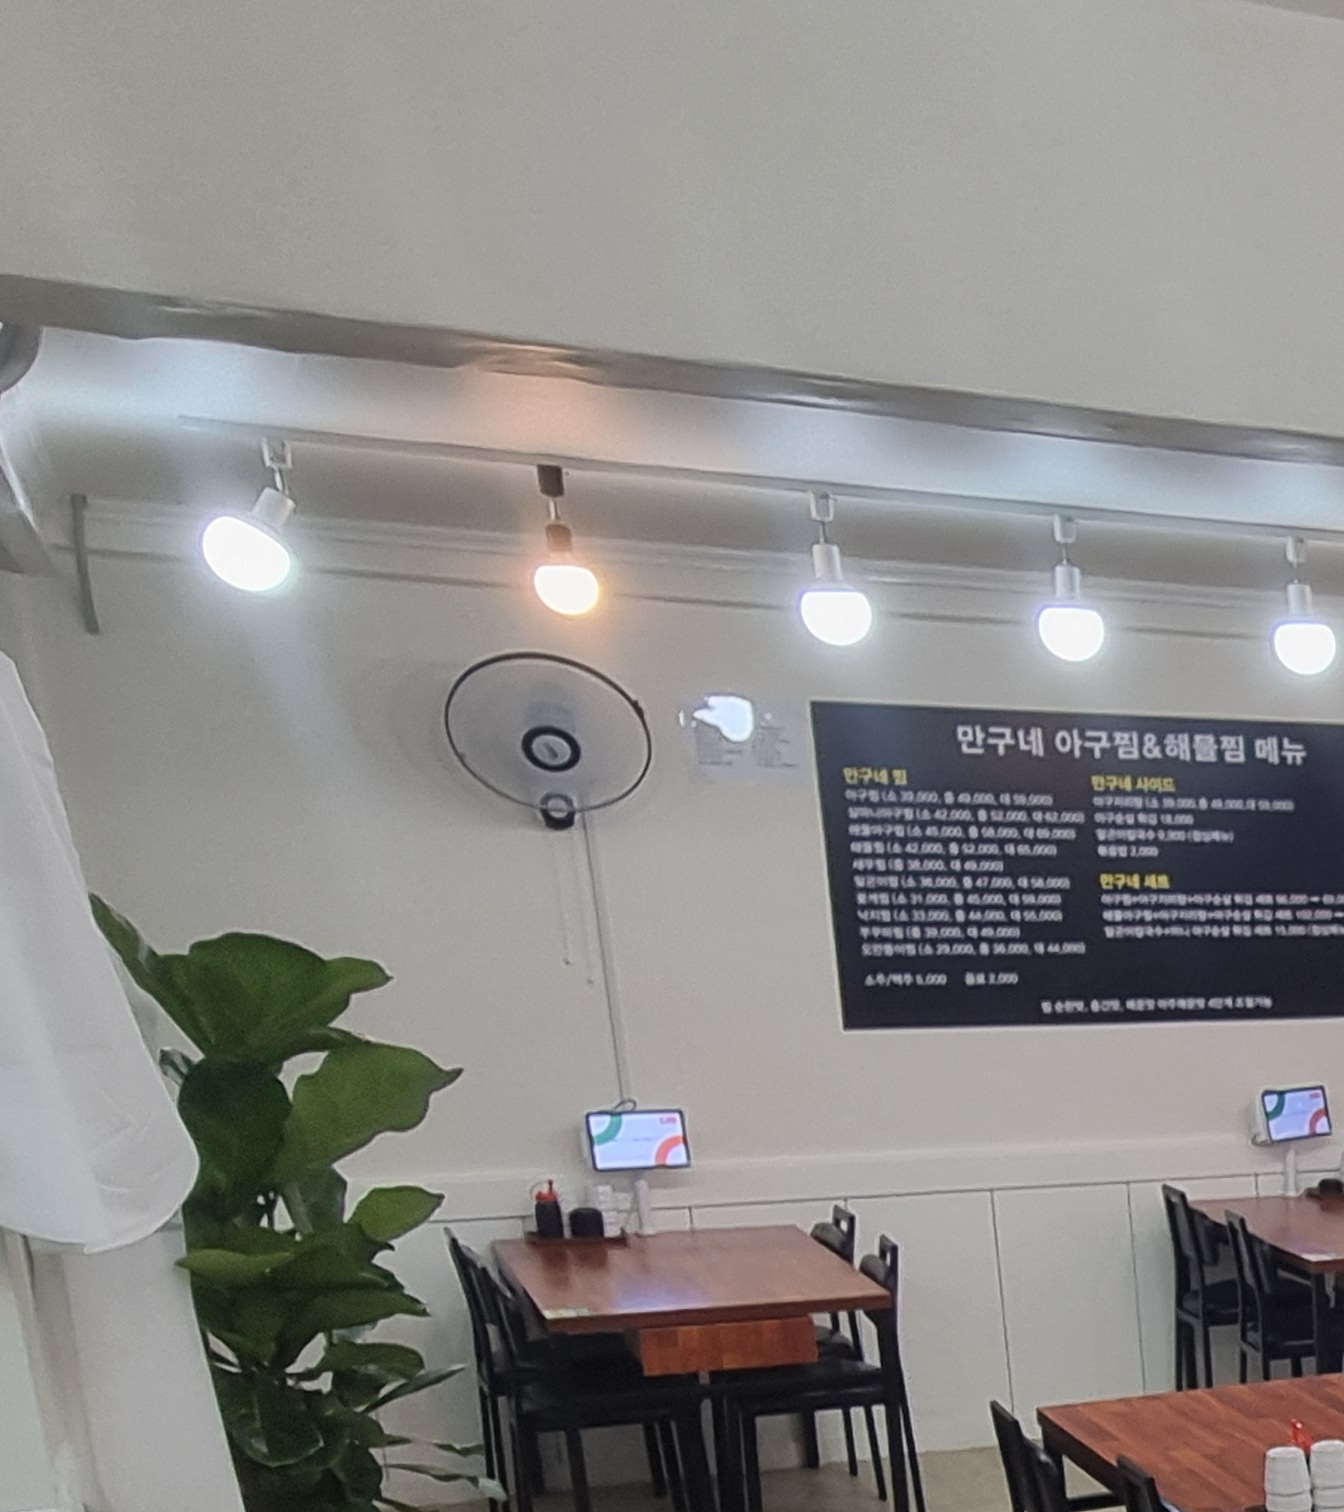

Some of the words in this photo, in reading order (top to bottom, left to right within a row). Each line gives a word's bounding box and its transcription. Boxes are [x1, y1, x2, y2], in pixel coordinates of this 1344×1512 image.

[956, 725, 1044, 757] 만구네
[1053, 728, 1245, 763] 아구찜&해물찜
[1253, 735, 1307, 765] 메뉴
[843, 767, 888, 785] 만구네
[1091, 774, 1133, 792] 만구네
[1135, 775, 1176, 793] 사이드
